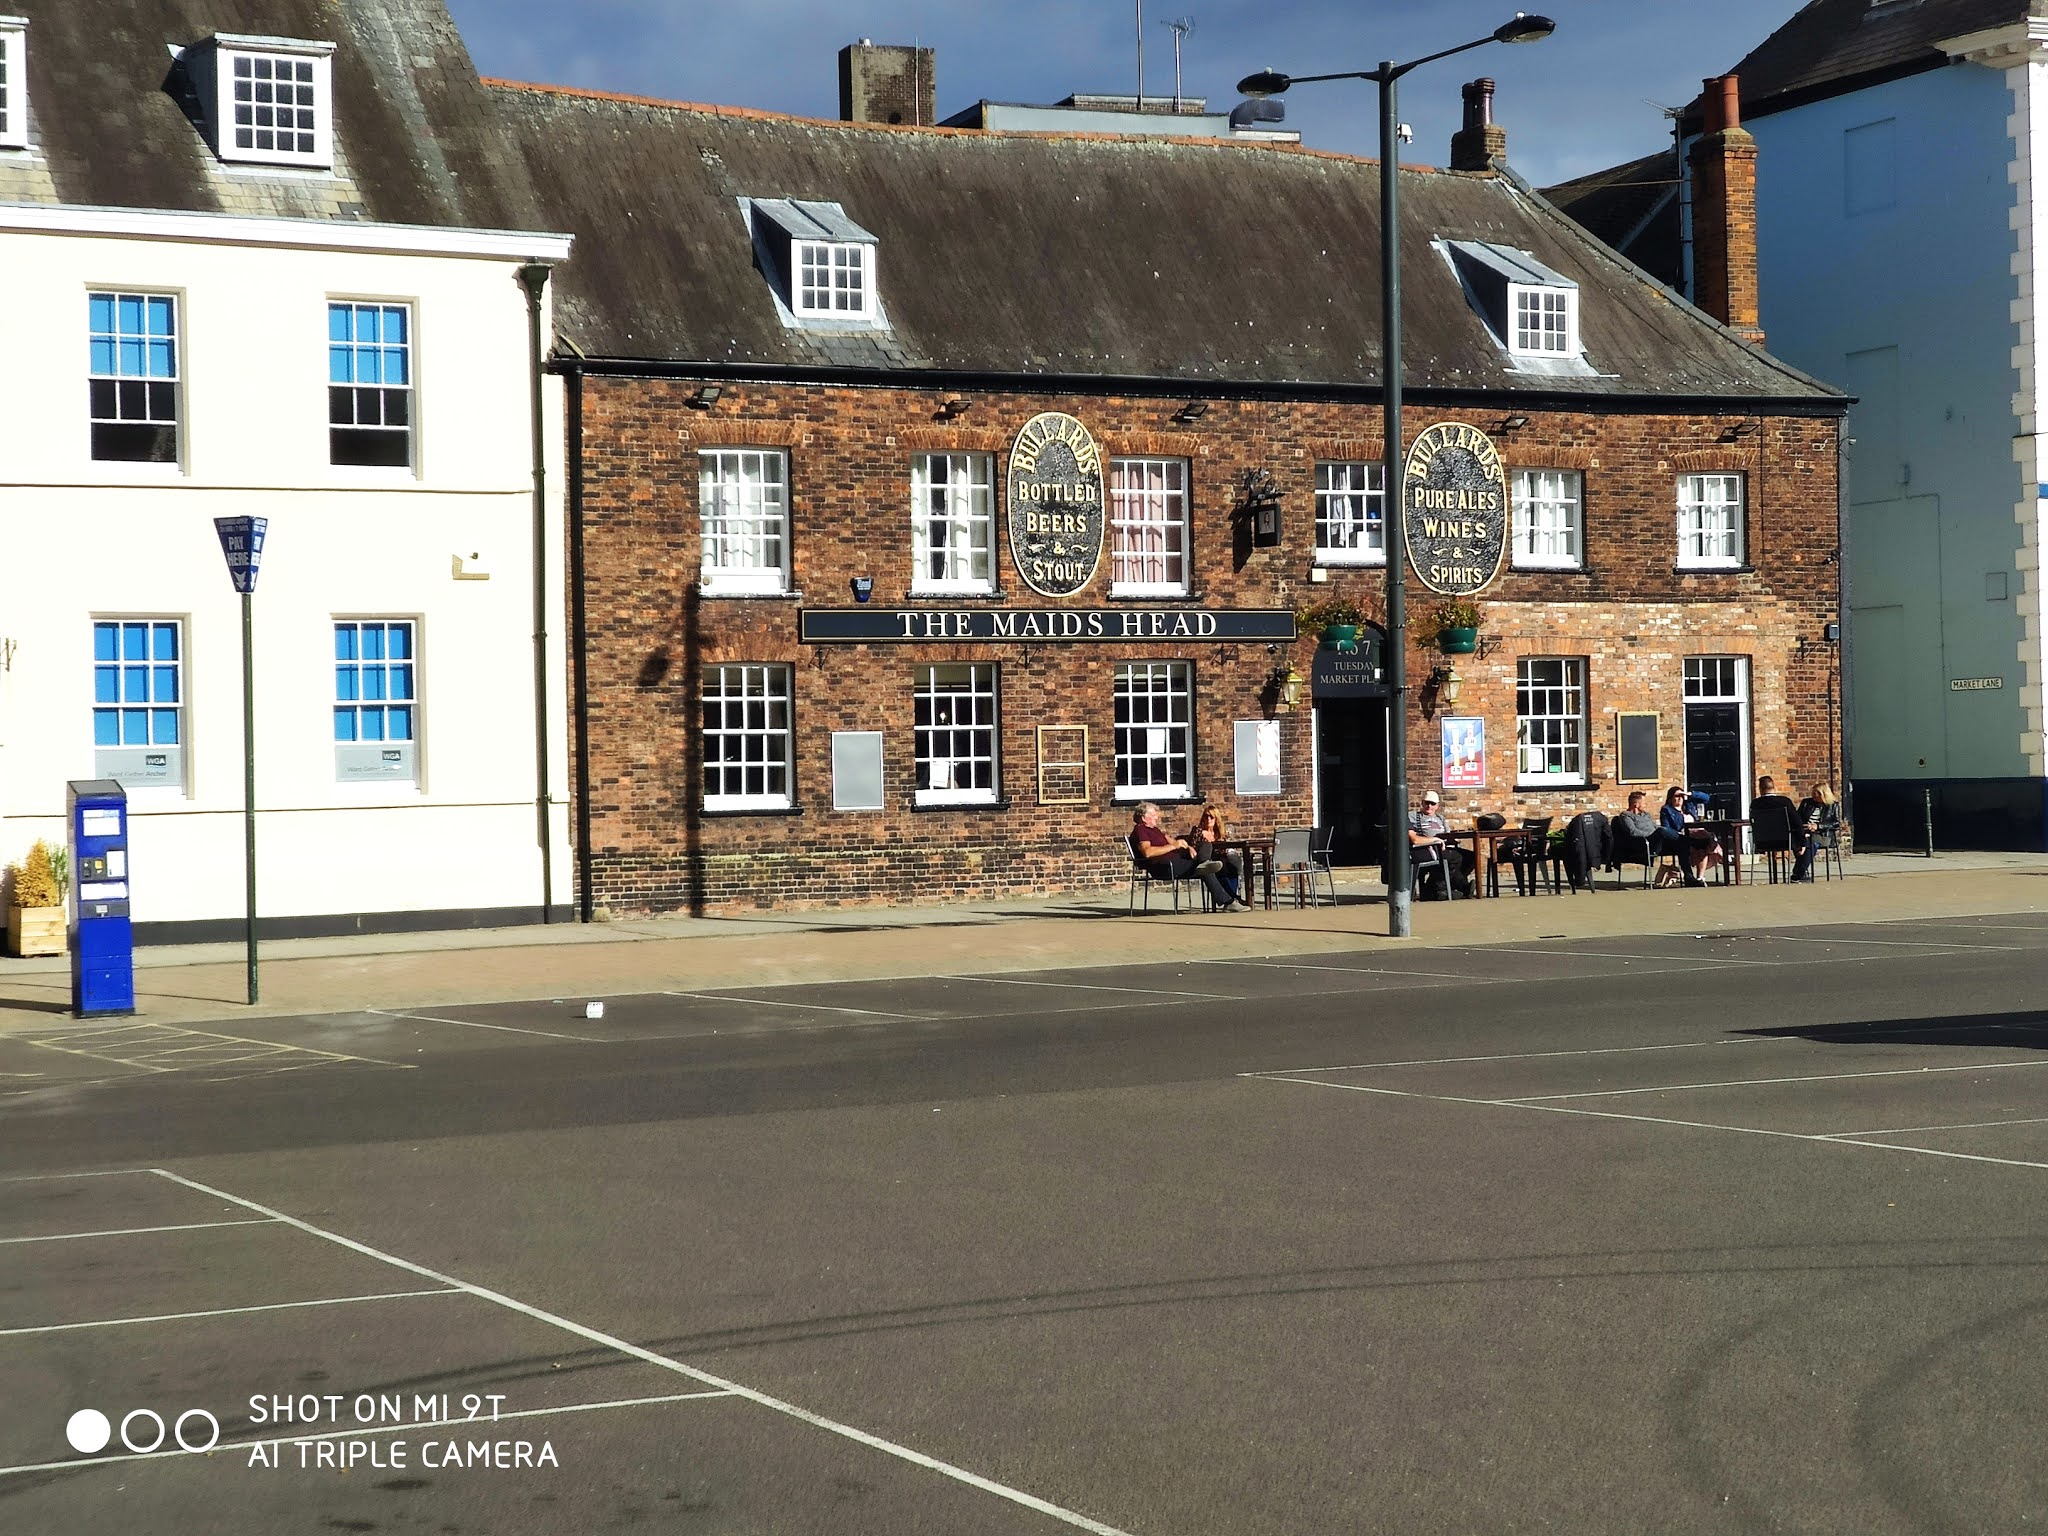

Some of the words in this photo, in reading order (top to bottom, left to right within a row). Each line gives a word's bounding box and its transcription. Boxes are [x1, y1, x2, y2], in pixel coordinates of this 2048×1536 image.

[1018, 481, 1095, 501] BOTTLED
[1414, 487, 1454, 509] PURE
[1457, 489, 1497, 510] ALES
[1026, 512, 1087, 533] BEERS
[1423, 517, 1487, 539] WINES
[228, 535, 244, 551] PAY
[1053, 541, 1066, 555] &
[226, 551, 250, 567] HERE
[1452, 546, 1463, 559] &
[1430, 565, 1483, 585] SPIRITS
[897, 612, 973, 637] THE
[991, 612, 1104, 637] MAIDS
[1120, 612, 1217, 637] HEAD
[1362, 640, 1371, 655] 7
[1334, 661, 1374, 671] TUESDAY
[1320, 674, 1360, 684] MARKET
[1361, 674, 1375, 684] PL
[1953, 680, 1980, 689] MARKET
[1982, 678, 2000, 688] LANE
[147, 757, 165, 765] WGA
[383, 752, 400, 760] WGA
